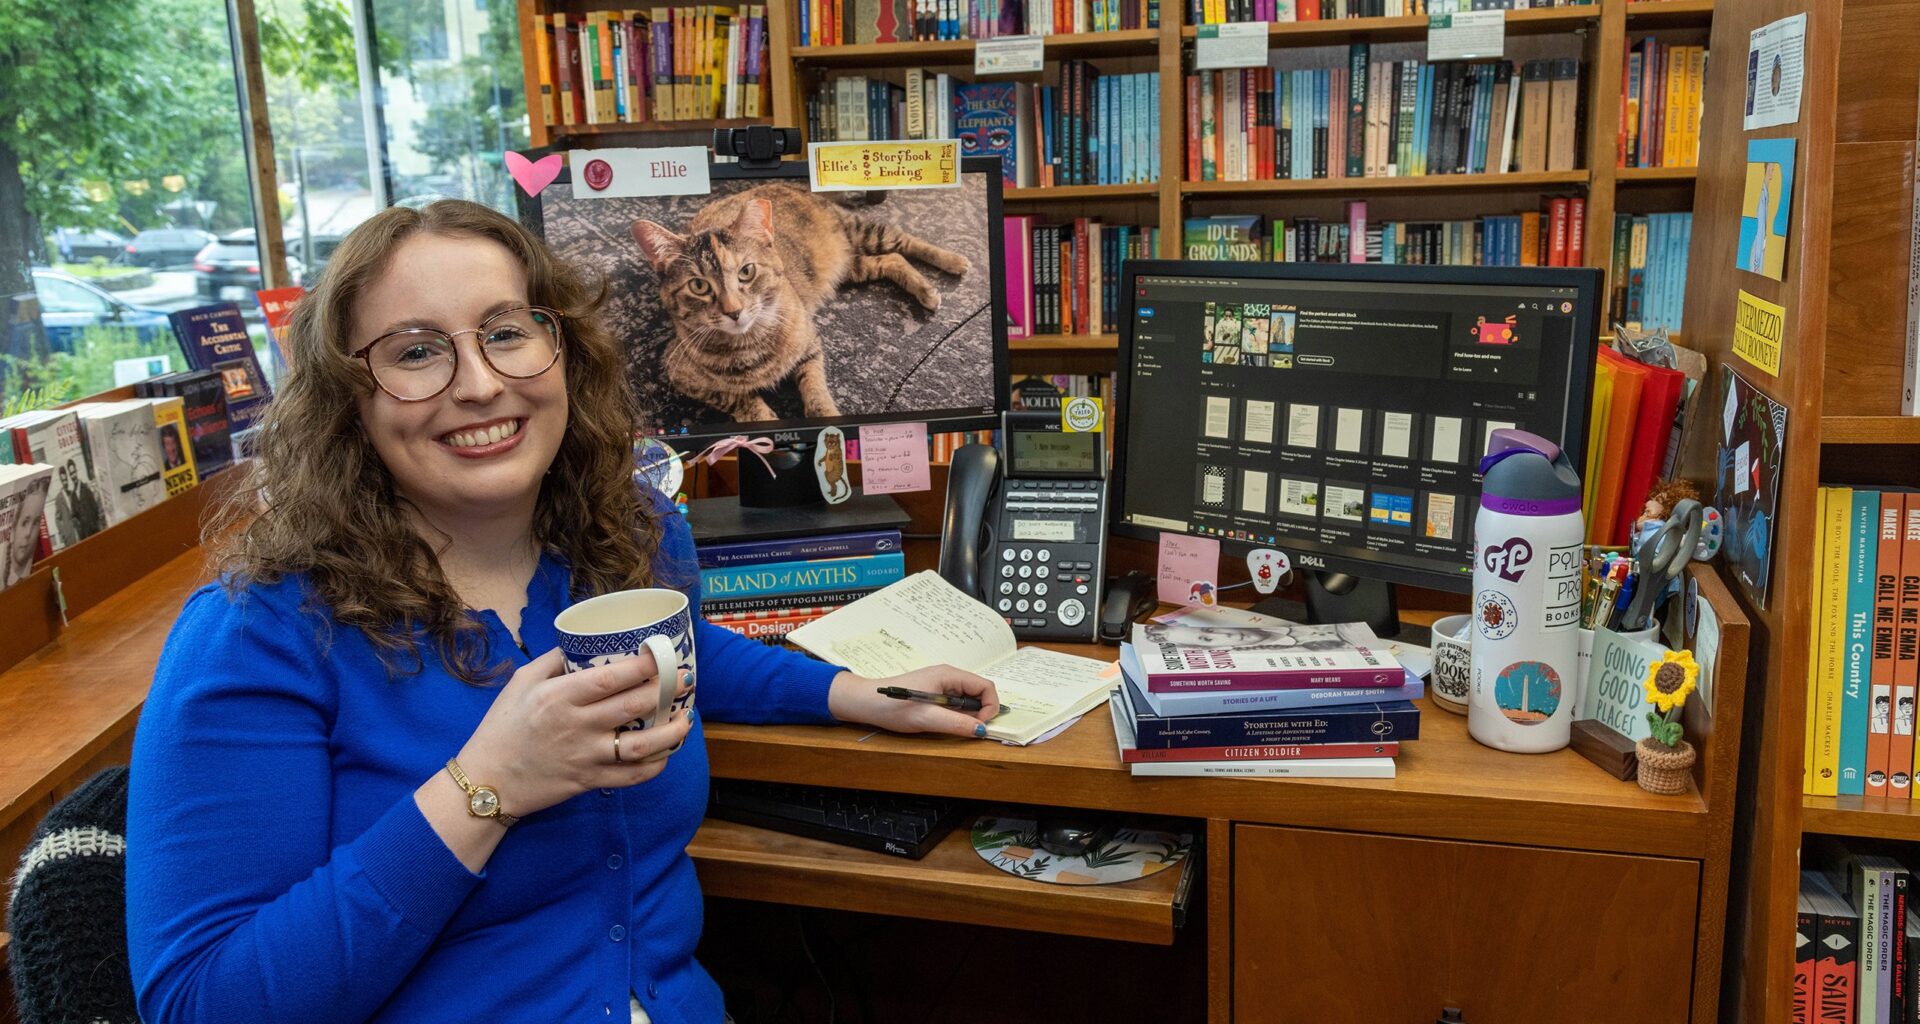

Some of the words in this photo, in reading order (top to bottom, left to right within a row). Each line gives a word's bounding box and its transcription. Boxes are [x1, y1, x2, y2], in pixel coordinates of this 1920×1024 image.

[1672, 51, 1683, 73] Libby
[1689, 51, 1700, 73] Libby
[1673, 75, 1681, 92] Lost
[1689, 75, 1698, 92] Lost
[910, 73, 919, 129] CONFESSIONS
[967, 100, 983, 110] THE
[986, 100, 1006, 109] SEA
[958, 116, 1014, 129] ELEPHANTS
[1671, 107, 1680, 133] Found
[1688, 107, 1697, 133] Found
[822, 160, 858, 172] Ellie's
[872, 149, 932, 164] Storybook
[649, 161, 687, 178] Ellie
[879, 167, 923, 182] Ending
[1207, 225, 1239, 241] IDLE
[1556, 220, 1564, 251] BARKER
[1573, 220, 1581, 250] BARKER
[1189, 244, 1257, 261] GROUNDS
[1747, 337, 1774, 369] ROONEY
[775, 432, 800, 442] DELL
[164, 469, 192, 491] NEWS
[1883, 508, 1898, 540] MAKEE
[1907, 509, 1920, 541] MAKEE
[1300, 555, 1325, 567] DELL
[1858, 537, 1866, 583] MAHDAVIAN
[709, 574, 776, 593] ISLAND
[780, 572, 791, 585] of
[795, 566, 857, 586] MYTHS
[867, 568, 899, 576] SODARO
[1878, 575, 1895, 603] CALL
[1903, 575, 1920, 604] CALL
[719, 601, 764, 610] ELEMENTS
[782, 595, 844, 606] TYPOGRAPHIC
[1853, 612, 1866, 638] This
[1877, 607, 1894, 623] ME
[1901, 607, 1918, 624] ME
[749, 622, 793, 638] Design
[1875, 626, 1893, 660] EMMA
[1899, 627, 1918, 661] EMMA
[1159, 643, 1184, 670] SOMETHING
[1184, 650, 1210, 670] WORTH
[1208, 650, 1236, 669] SAVING
[1605, 642, 1646, 680] GOING
[1846, 643, 1864, 699] Country
[1311, 691, 1340, 700] DEBORAH
[1342, 690, 1364, 698] TAKIFF
[1366, 688, 1384, 696] SMITH
[1599, 670, 1641, 709] GOOD
[1243, 720, 1289, 730] STORYTIME
[1596, 699, 1636, 736] PLACES
[1824, 724, 1832, 757] MACKESY
[1225, 749, 1260, 757] CITIZEN
[1264, 748, 1301, 756] SOLDIER
[886, 842, 896, 852] RK
[1897, 895, 1905, 929] NEMESIS:
[1895, 964, 1903, 998] GALLERY
